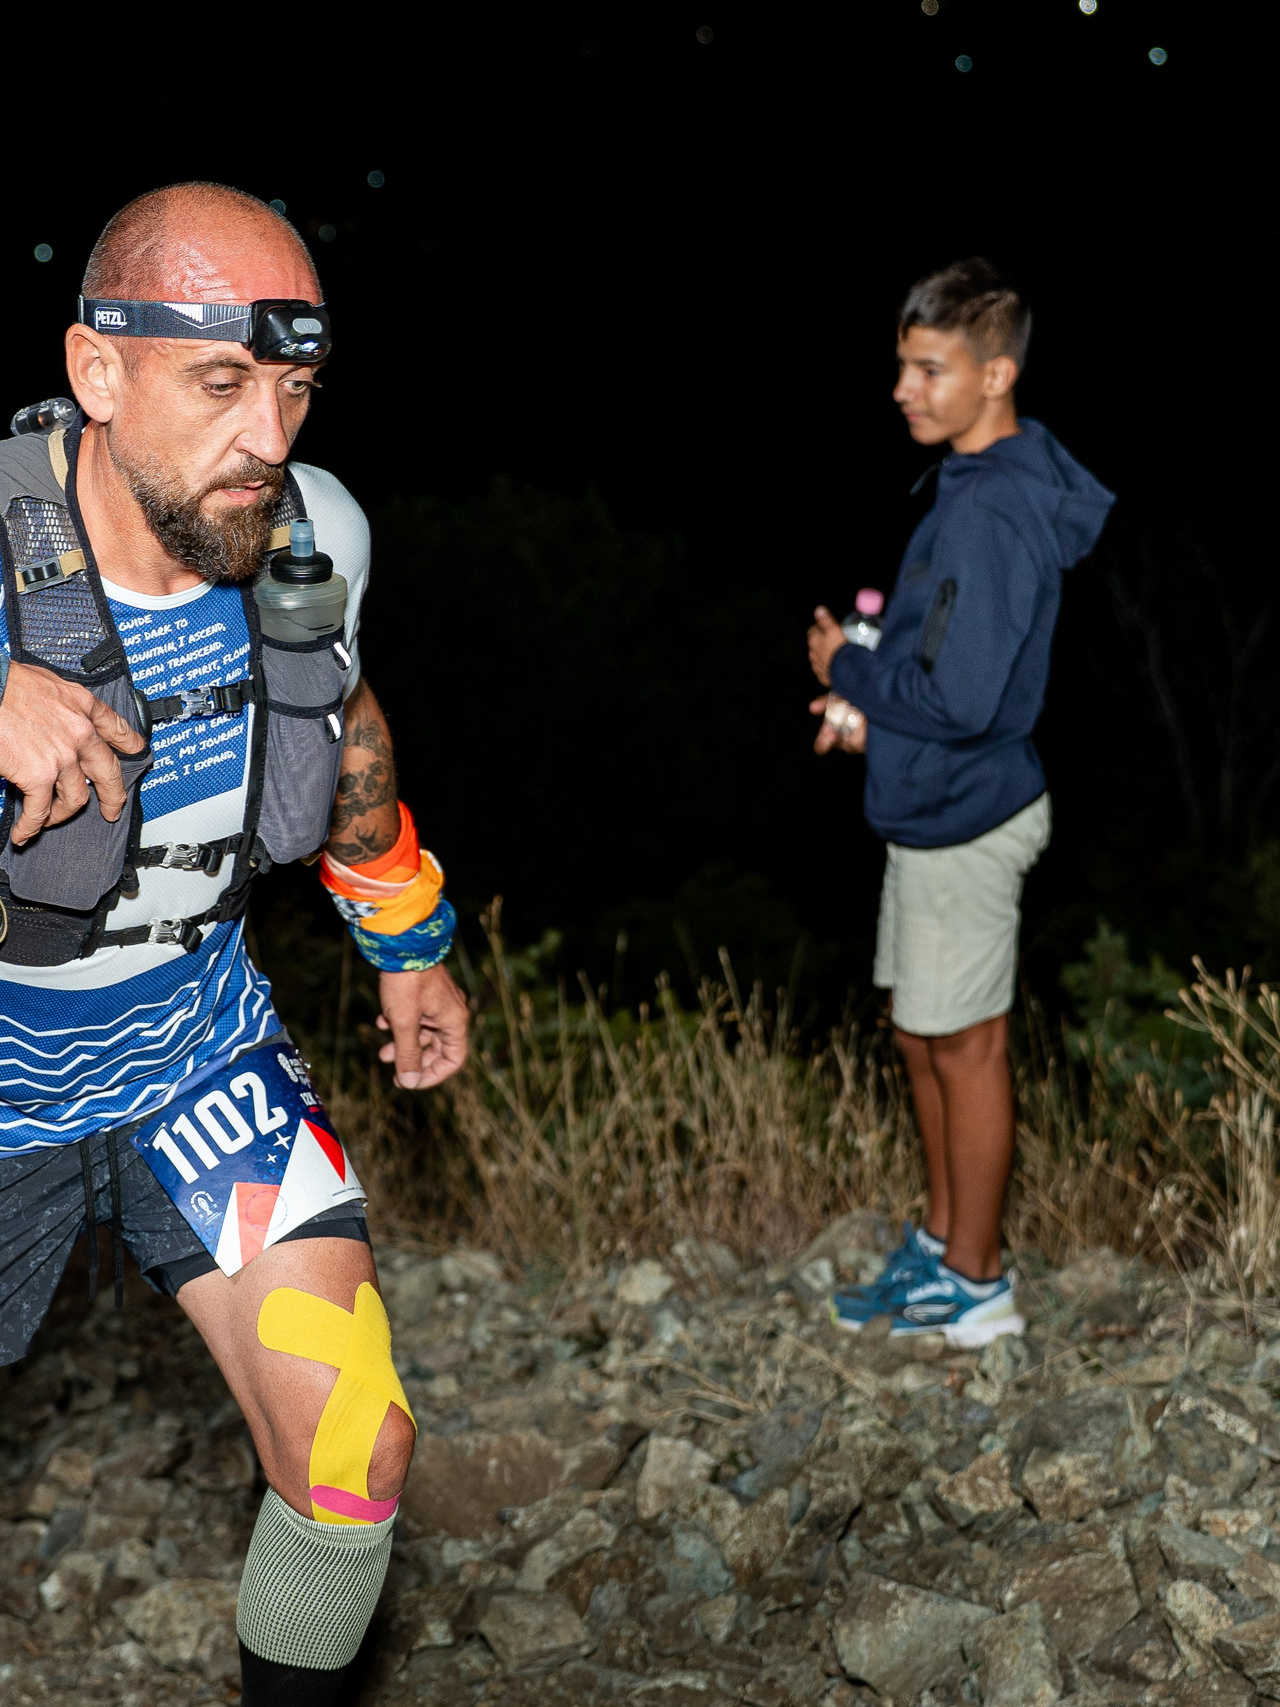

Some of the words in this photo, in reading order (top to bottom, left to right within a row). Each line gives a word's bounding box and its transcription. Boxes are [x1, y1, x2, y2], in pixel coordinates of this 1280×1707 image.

[95, 309, 127, 330] PETZL
[118, 614, 152, 631] GUIDE
[122, 634, 142, 647] WS
[144, 624, 173, 641] DARK
[174, 618, 189, 630] TO
[178, 635, 186, 648] I
[188, 622, 227, 644] ASCEND,
[132, 664, 165, 682] REATH
[167, 641, 225, 669] TRANSCEND.
[225, 667, 243, 683] AND
[143, 681, 167, 696] GTH
[170, 673, 185, 687] OF
[186, 660, 221, 681] SPIRIT,
[152, 727, 193, 751] BRIGHT
[194, 723, 206, 735] IN
[152, 755, 174, 770] ETE,
[179, 744, 197, 758] MY
[199, 723, 244, 751] JOURNEY
[140, 770, 179, 792] OSMOS,
[183, 764, 191, 776] I
[194, 750, 237, 772] EXPAND,
[152, 1071, 289, 1185] 1102
